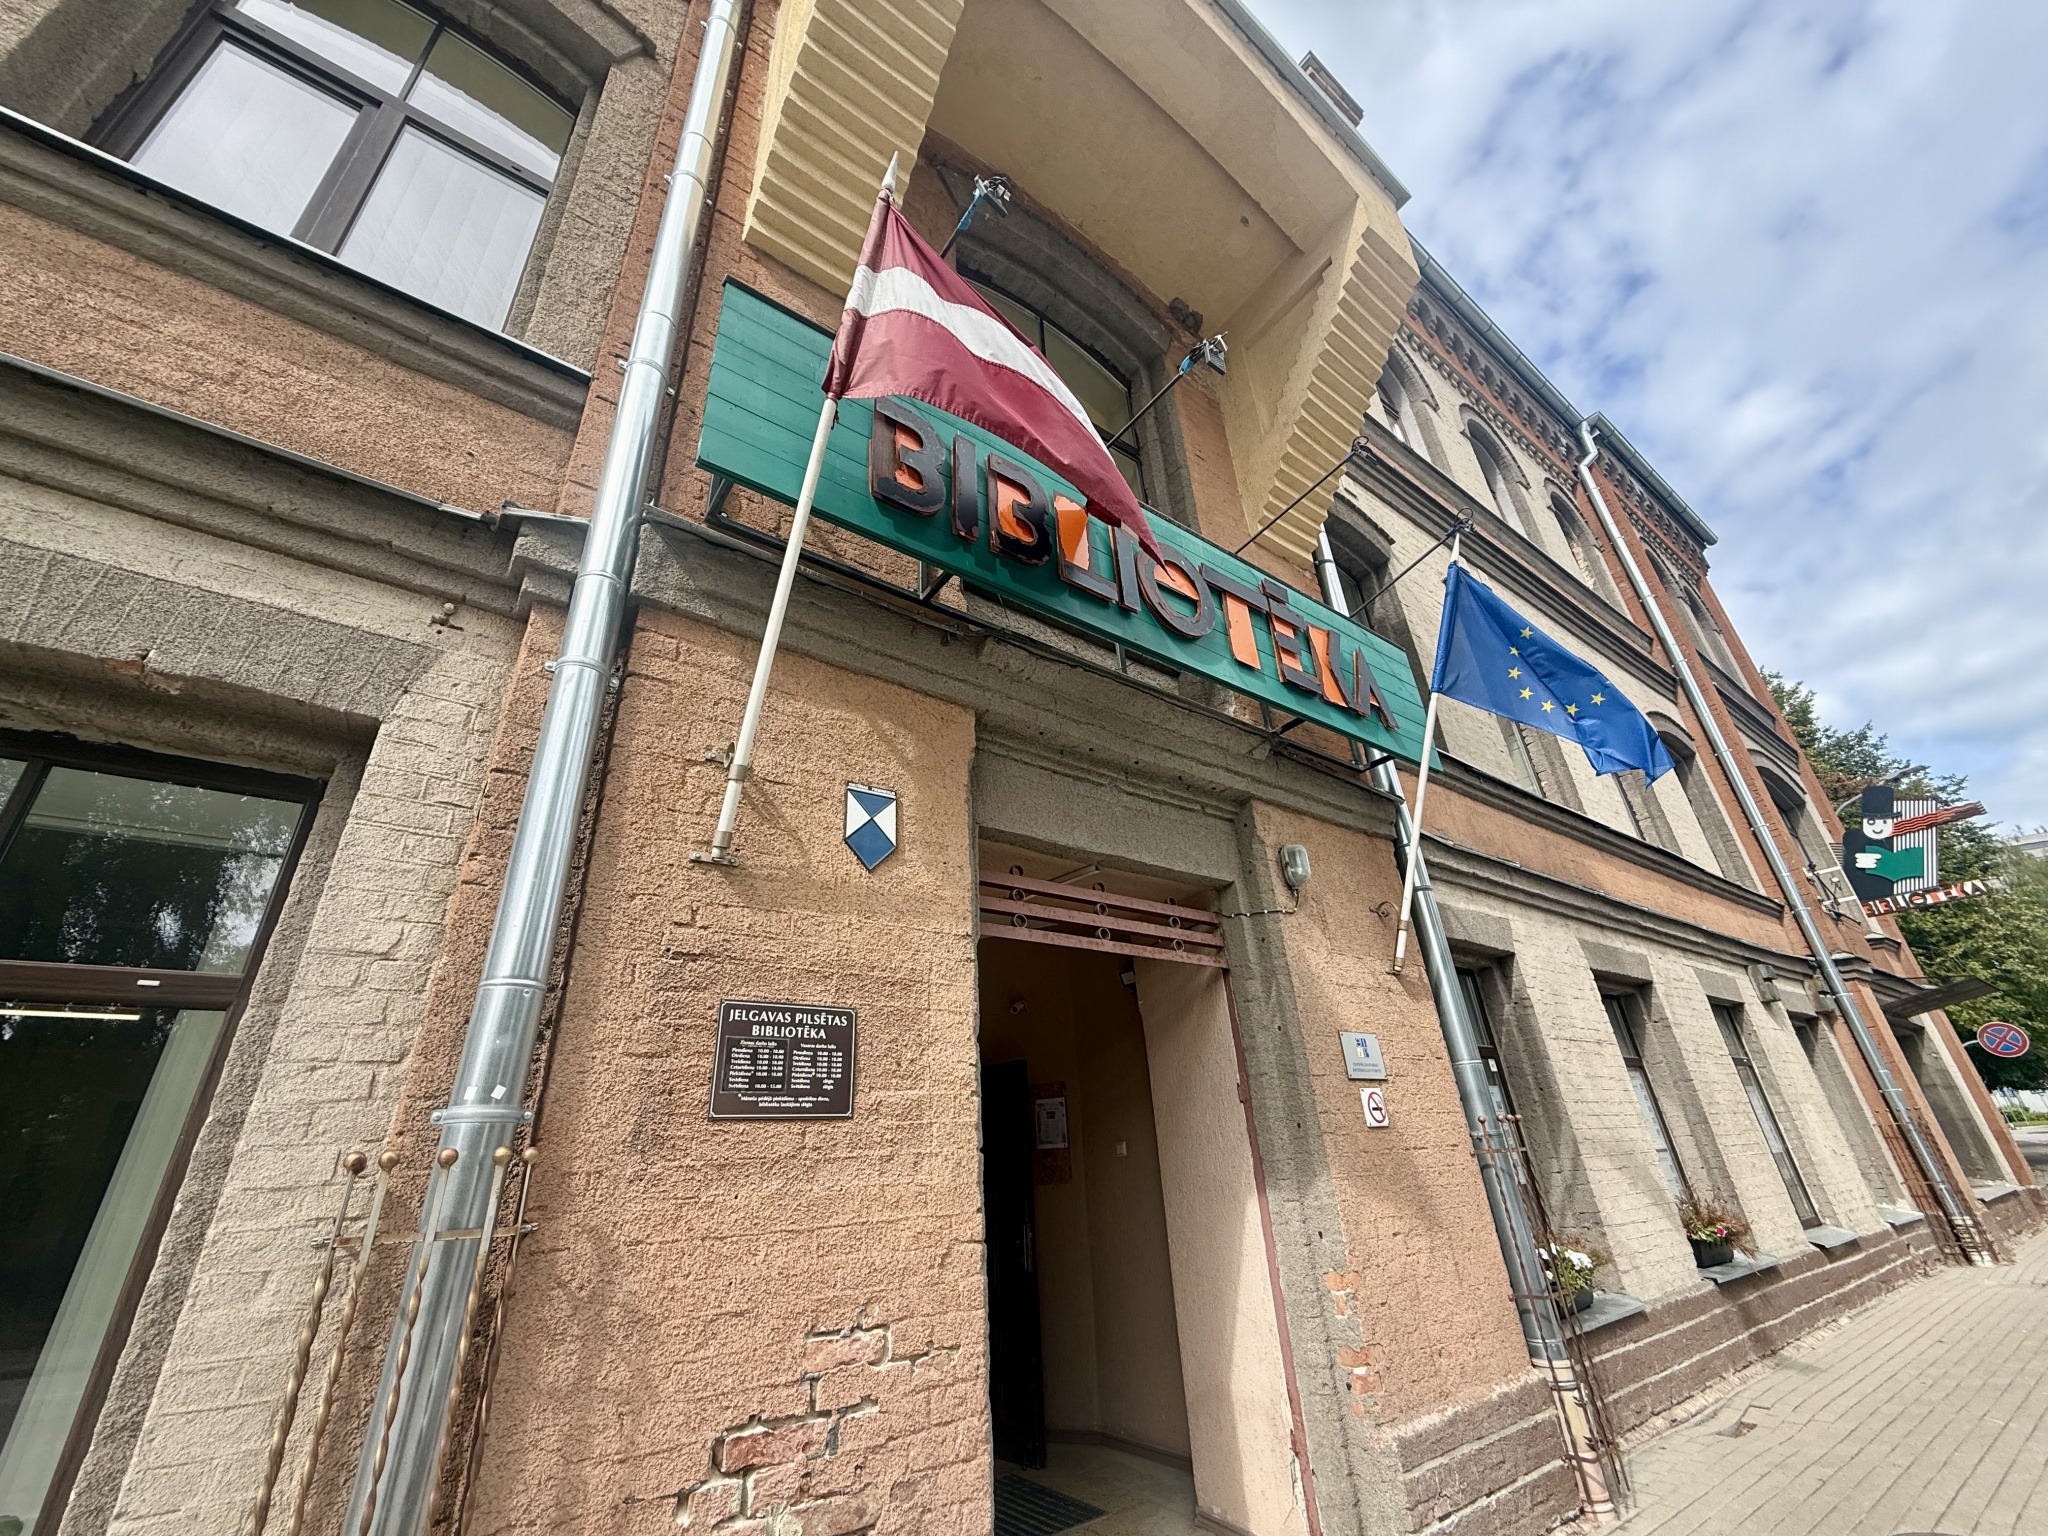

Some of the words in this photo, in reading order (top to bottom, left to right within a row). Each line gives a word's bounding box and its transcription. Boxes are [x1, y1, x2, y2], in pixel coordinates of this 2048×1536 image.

[869, 397, 1398, 730] BIBLIOTĒKA
[729, 1009, 791, 1022] JELGAVAS
[795, 1012, 848, 1026] PILSĒTAS
[752, 1025, 826, 1039] BIBLIOTĒKA
